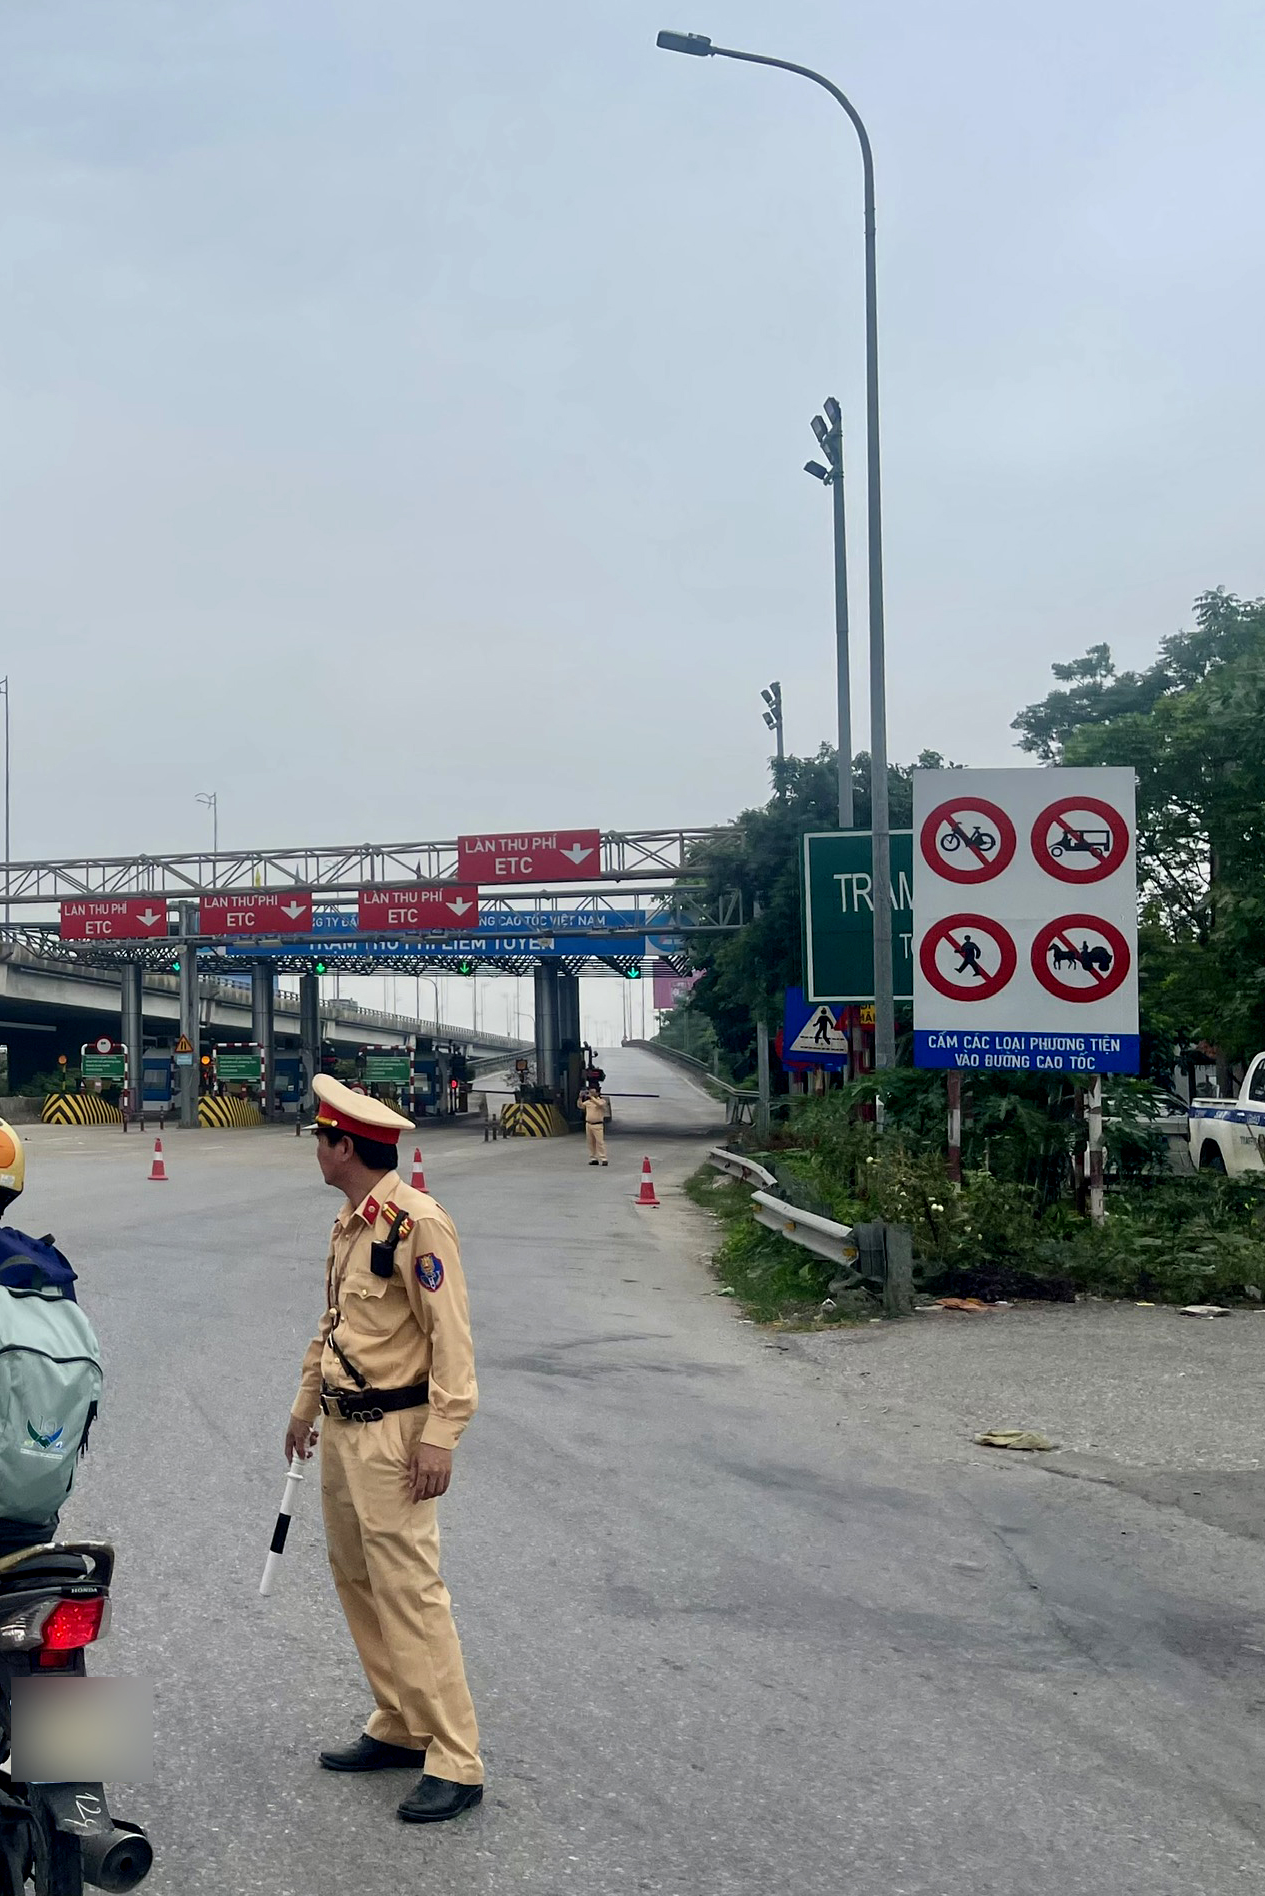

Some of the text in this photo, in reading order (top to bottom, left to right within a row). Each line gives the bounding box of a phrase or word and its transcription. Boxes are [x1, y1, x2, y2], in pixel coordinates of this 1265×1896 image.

[465, 833, 558, 854] LÀN THU PHÍ
[495, 856, 534, 875] ETC
[363, 888, 444, 905] LÀN THU PHÍ
[64, 901, 128, 917] LÀN THU PHÍ
[387, 909, 419, 924] ETC
[85, 920, 112, 935] ETC
[226, 912, 256, 927] ETC
[577, 915, 606, 926] NAM
[928, 1030, 1120, 1055] CẤM CÁC LOẠI PHƯƠNG TIỆN
[954, 1050, 980, 1067] VÀO
[1036, 1055, 1063, 1069] CAO
[1069, 1051, 1096, 1070] TỐC
